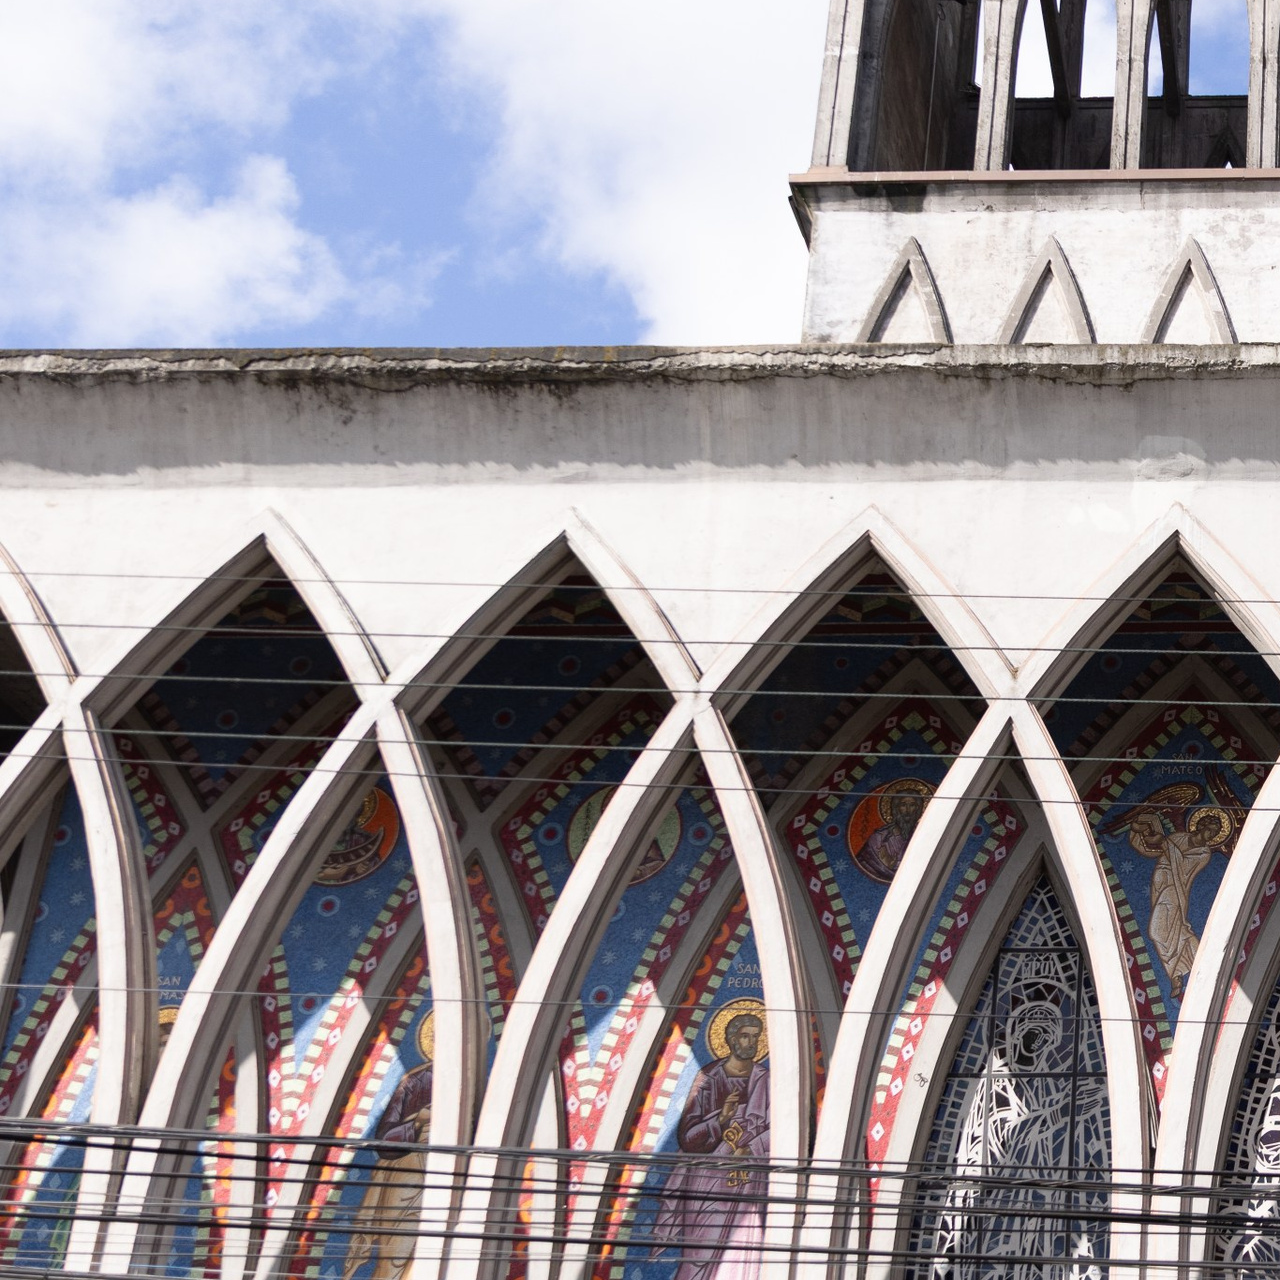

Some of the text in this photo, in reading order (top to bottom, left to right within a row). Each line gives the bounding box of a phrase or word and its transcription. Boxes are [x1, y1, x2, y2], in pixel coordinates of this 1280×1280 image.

[1161, 765, 1203, 775] MATEO
[736, 962, 761, 974] SAN
[157, 975, 181, 986] SAN
